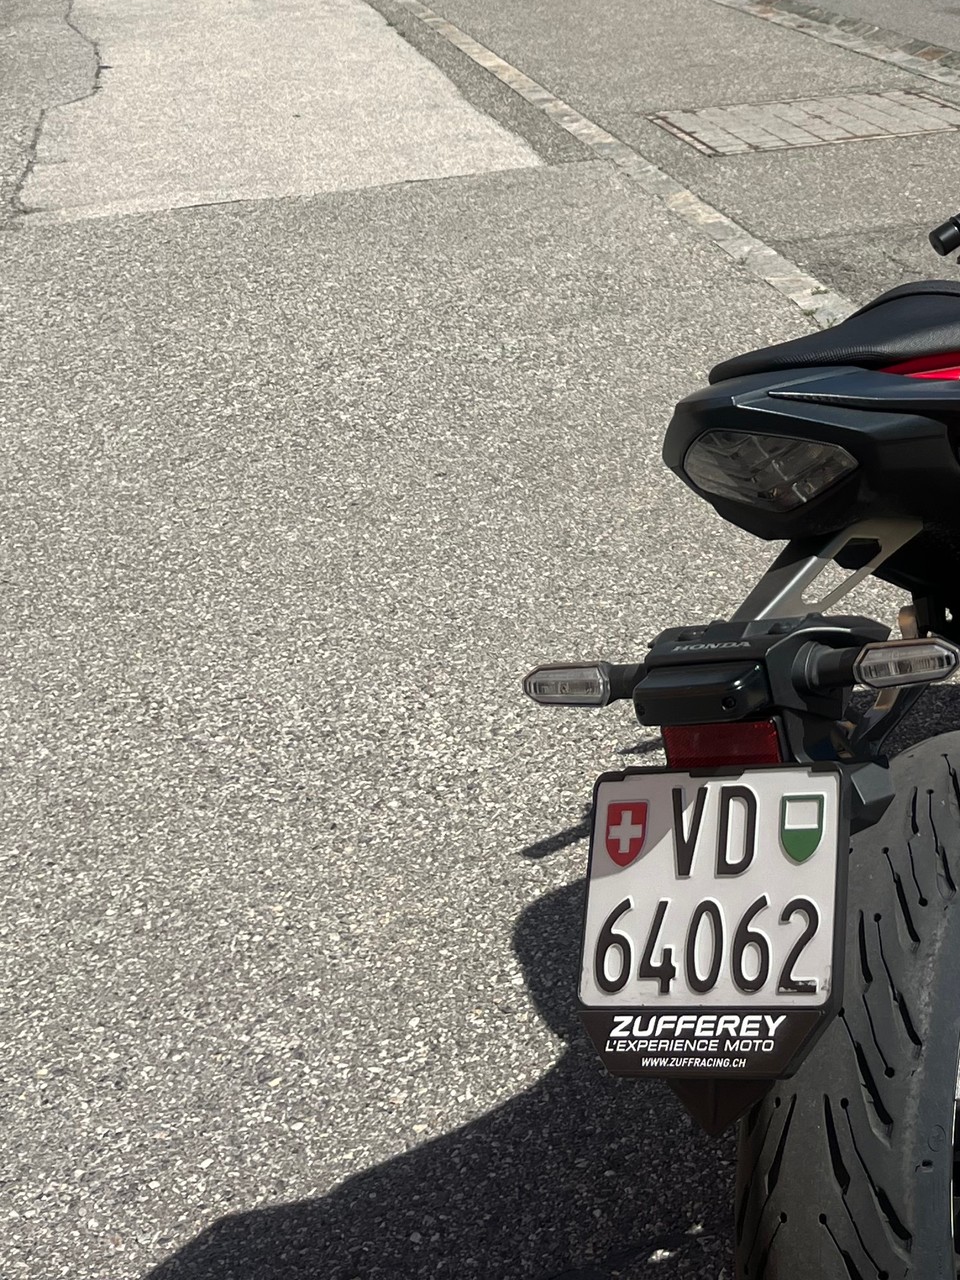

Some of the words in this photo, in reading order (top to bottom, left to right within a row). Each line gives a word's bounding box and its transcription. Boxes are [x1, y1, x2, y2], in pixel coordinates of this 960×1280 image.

[671, 641, 752, 652] HONDA
[672, 785, 759, 878] VD
[595, 895, 820, 994] 64062
[609, 1015, 787, 1037] ZUFFEREY
[605, 1039, 719, 1052] L'EXPERIENCE
[723, 1039, 775, 1052] MOTO
[641, 1057, 747, 1068] WWW.ZUFFRACING.CH
